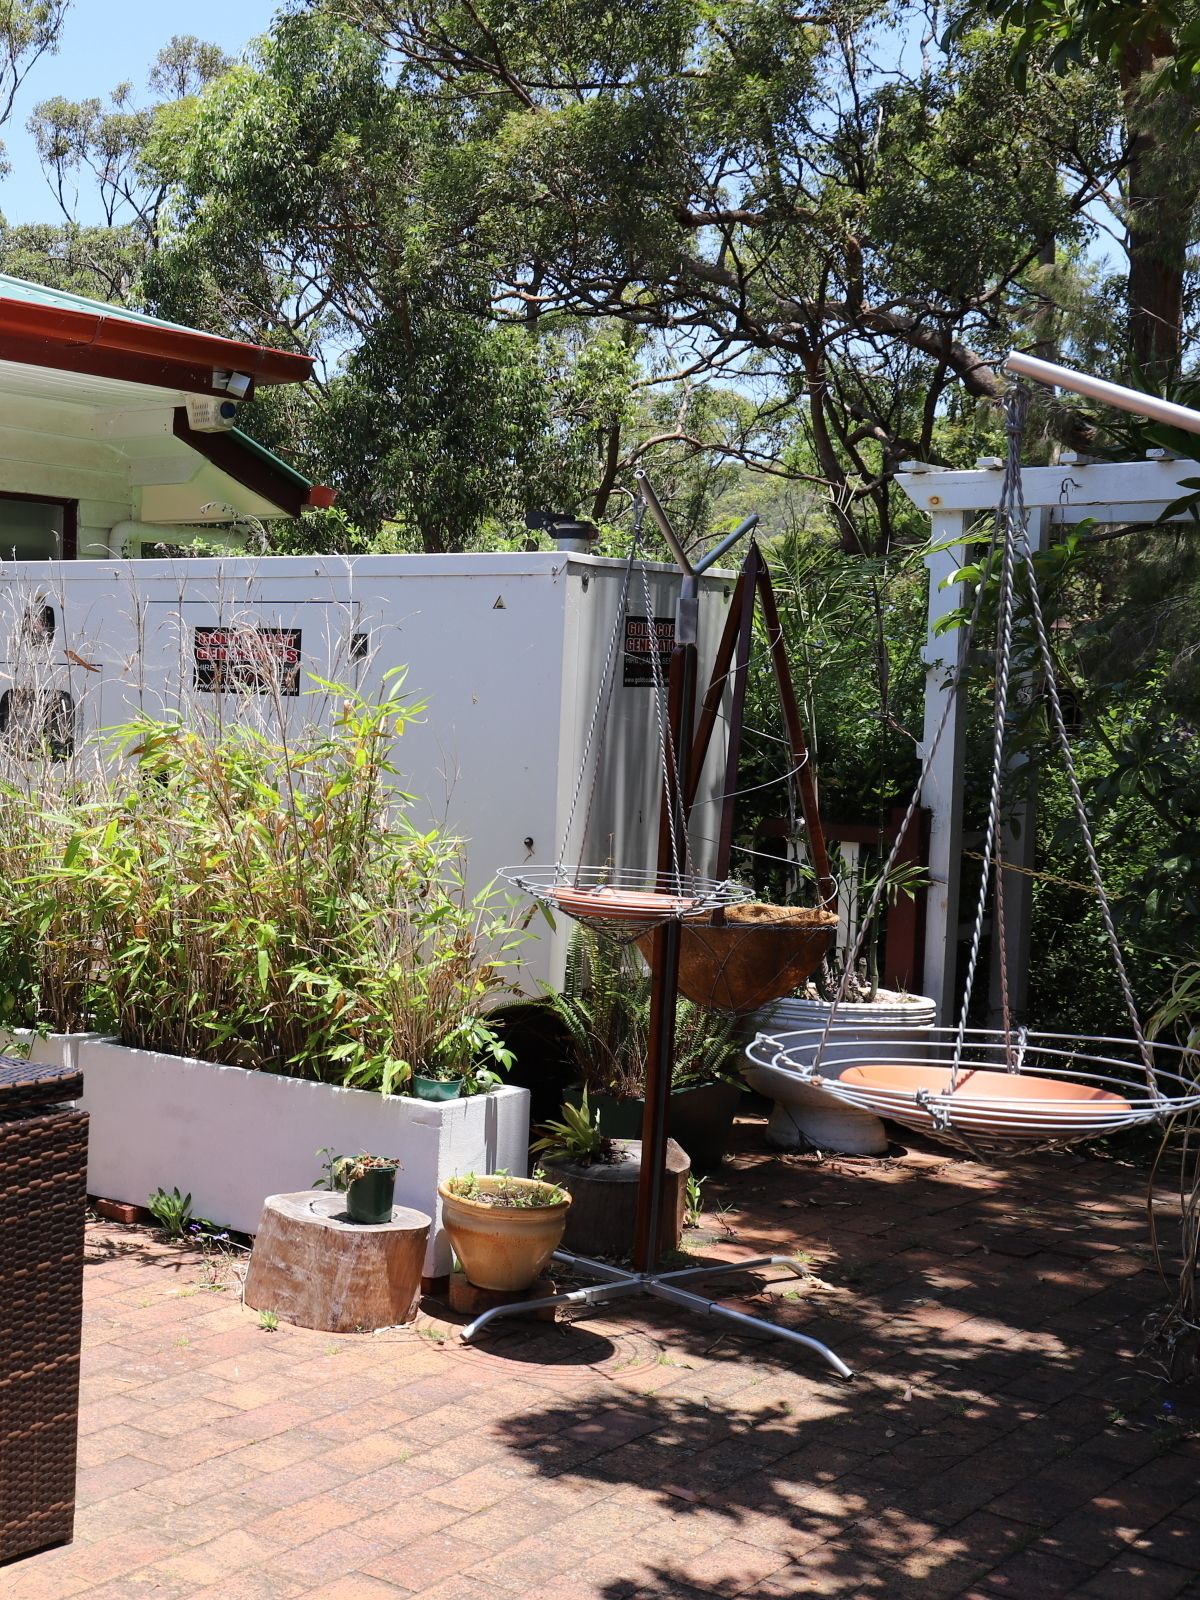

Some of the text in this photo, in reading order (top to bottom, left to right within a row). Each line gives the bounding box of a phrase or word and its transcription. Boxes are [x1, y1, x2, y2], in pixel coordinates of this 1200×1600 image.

[628, 622, 676, 637] GOL COA
[626, 638, 675, 652] GENEATO
